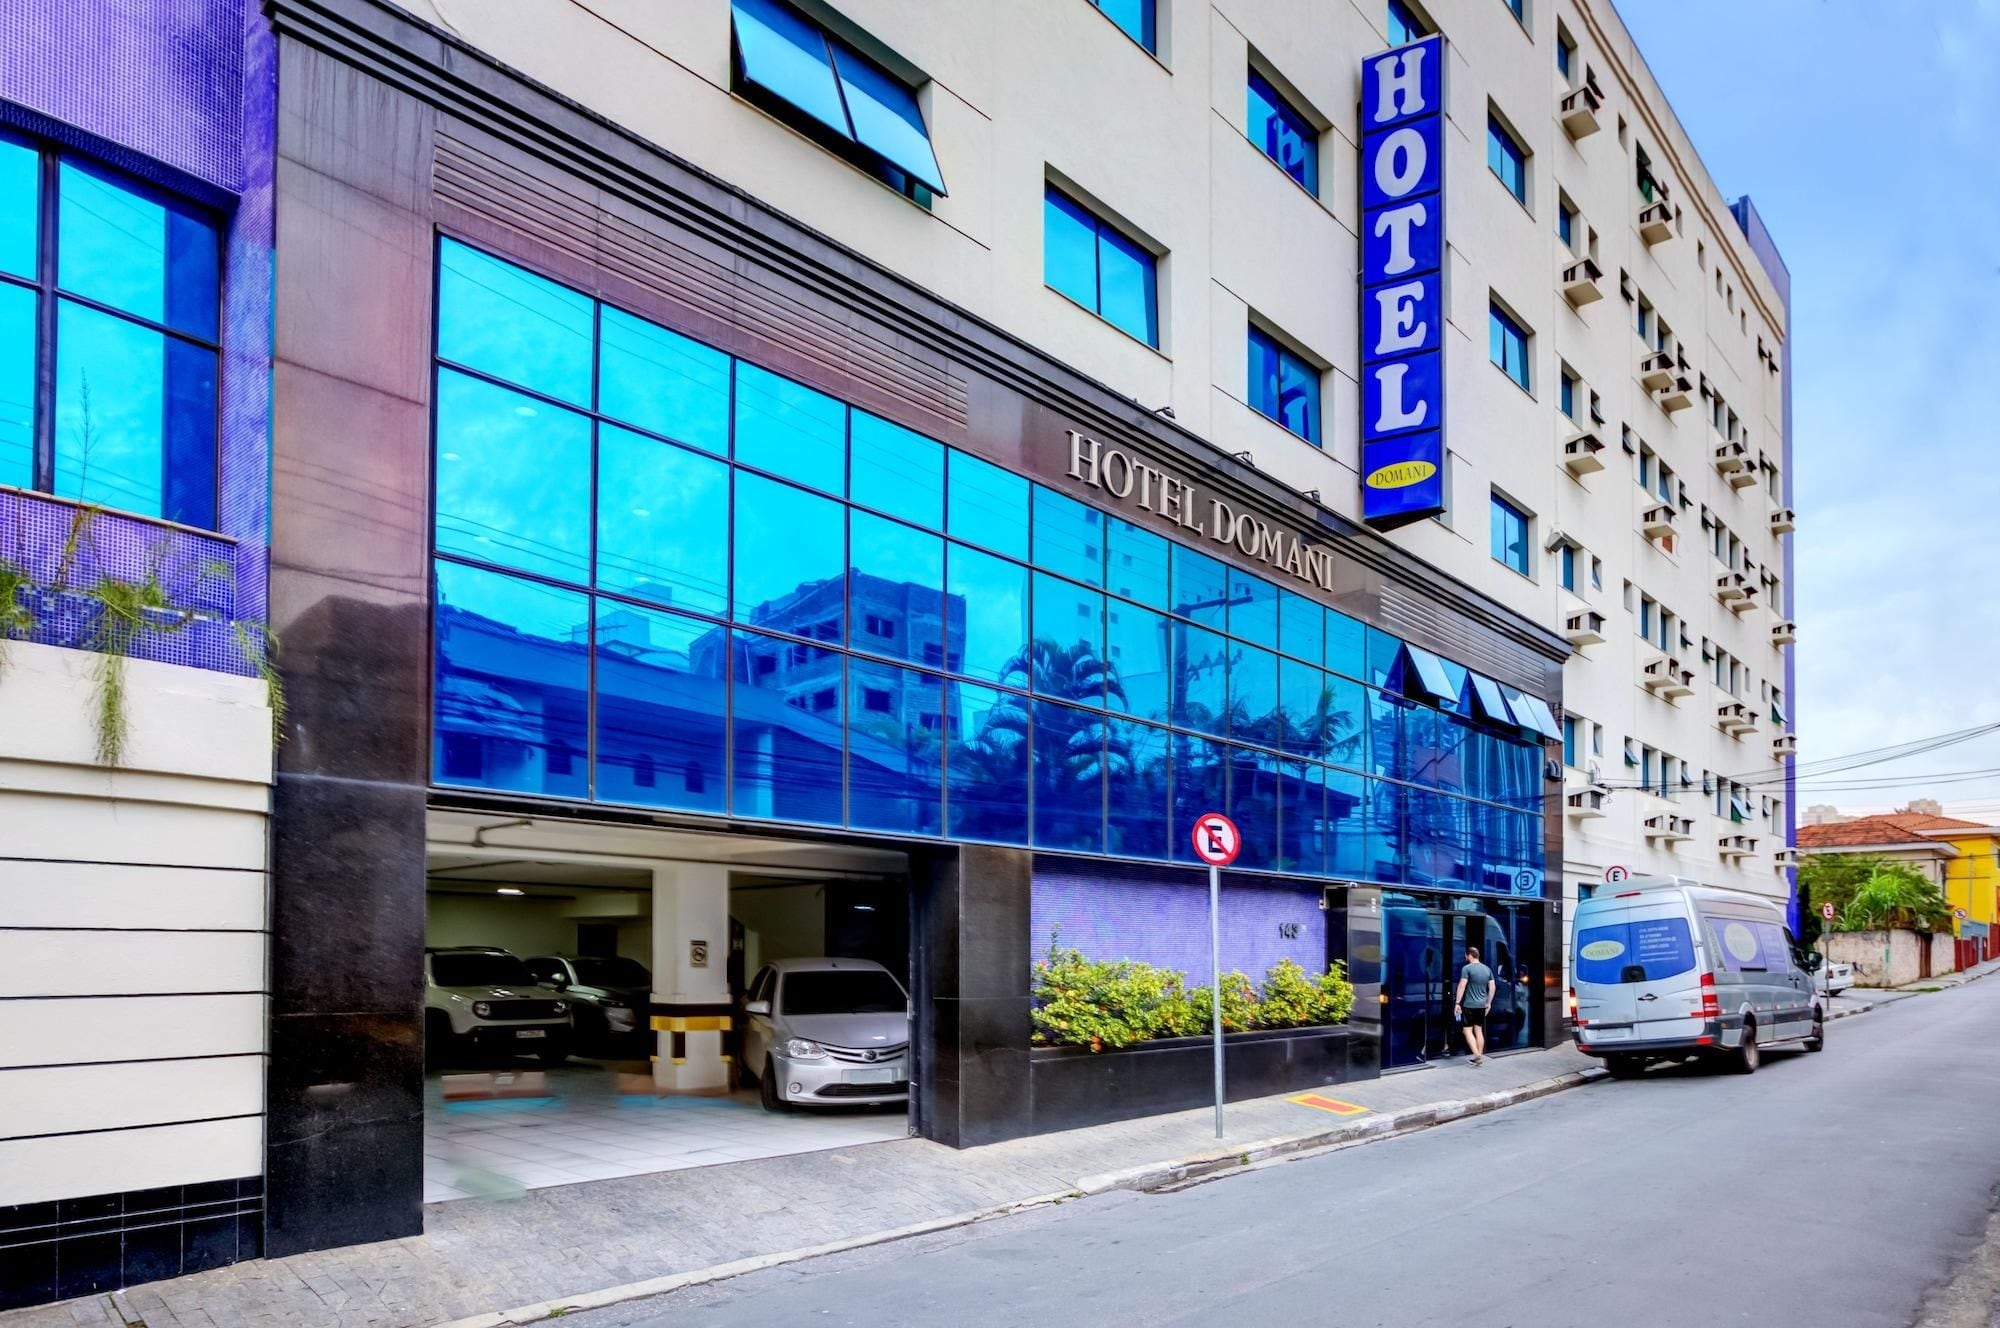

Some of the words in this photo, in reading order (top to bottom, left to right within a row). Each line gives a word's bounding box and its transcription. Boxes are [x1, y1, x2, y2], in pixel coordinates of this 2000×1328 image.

[1374, 46, 1427, 433] HOTEL
[1375, 464, 1426, 486] DOMANI
[1065, 429, 1204, 537] HOTEL
[1209, 498, 1334, 593] DOMANI
[1208, 825, 1224, 853] E
[1613, 870, 1620, 882] E
